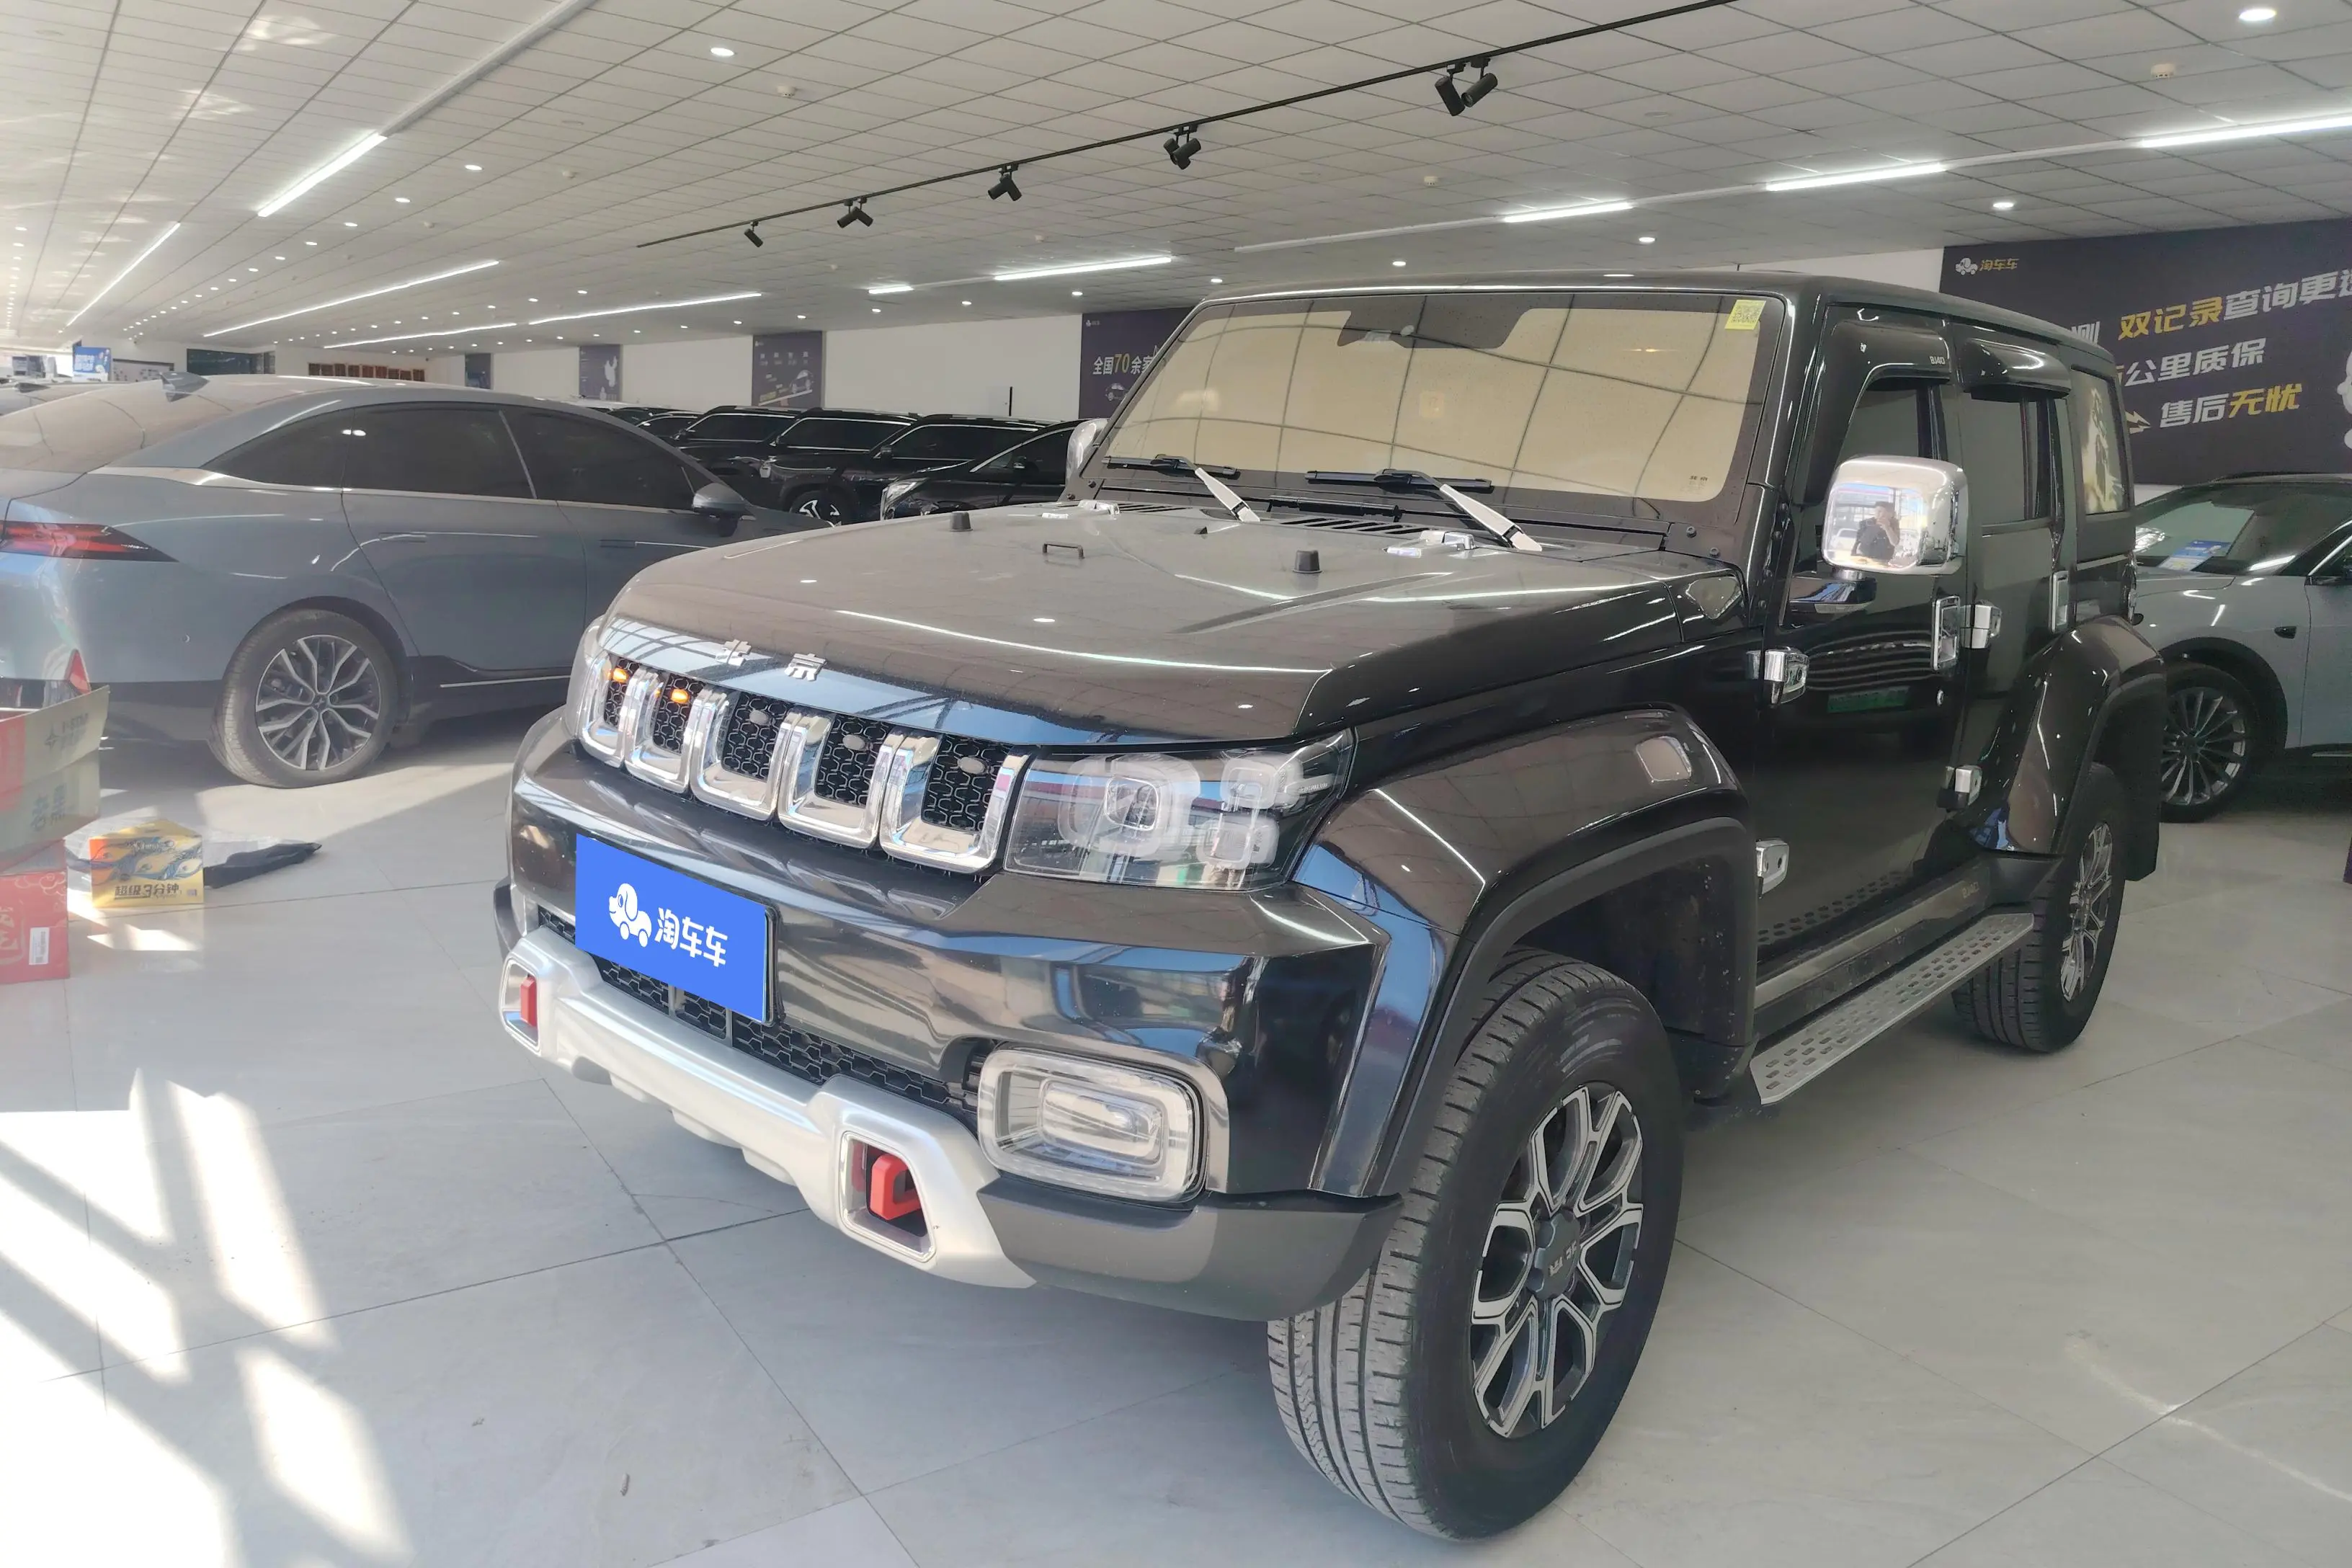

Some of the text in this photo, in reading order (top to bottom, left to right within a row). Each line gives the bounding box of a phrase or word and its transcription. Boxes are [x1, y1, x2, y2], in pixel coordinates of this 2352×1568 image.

[1979, 257, 2019, 272] 淘车车
[2160, 383, 2303, 429] 售后无忧
